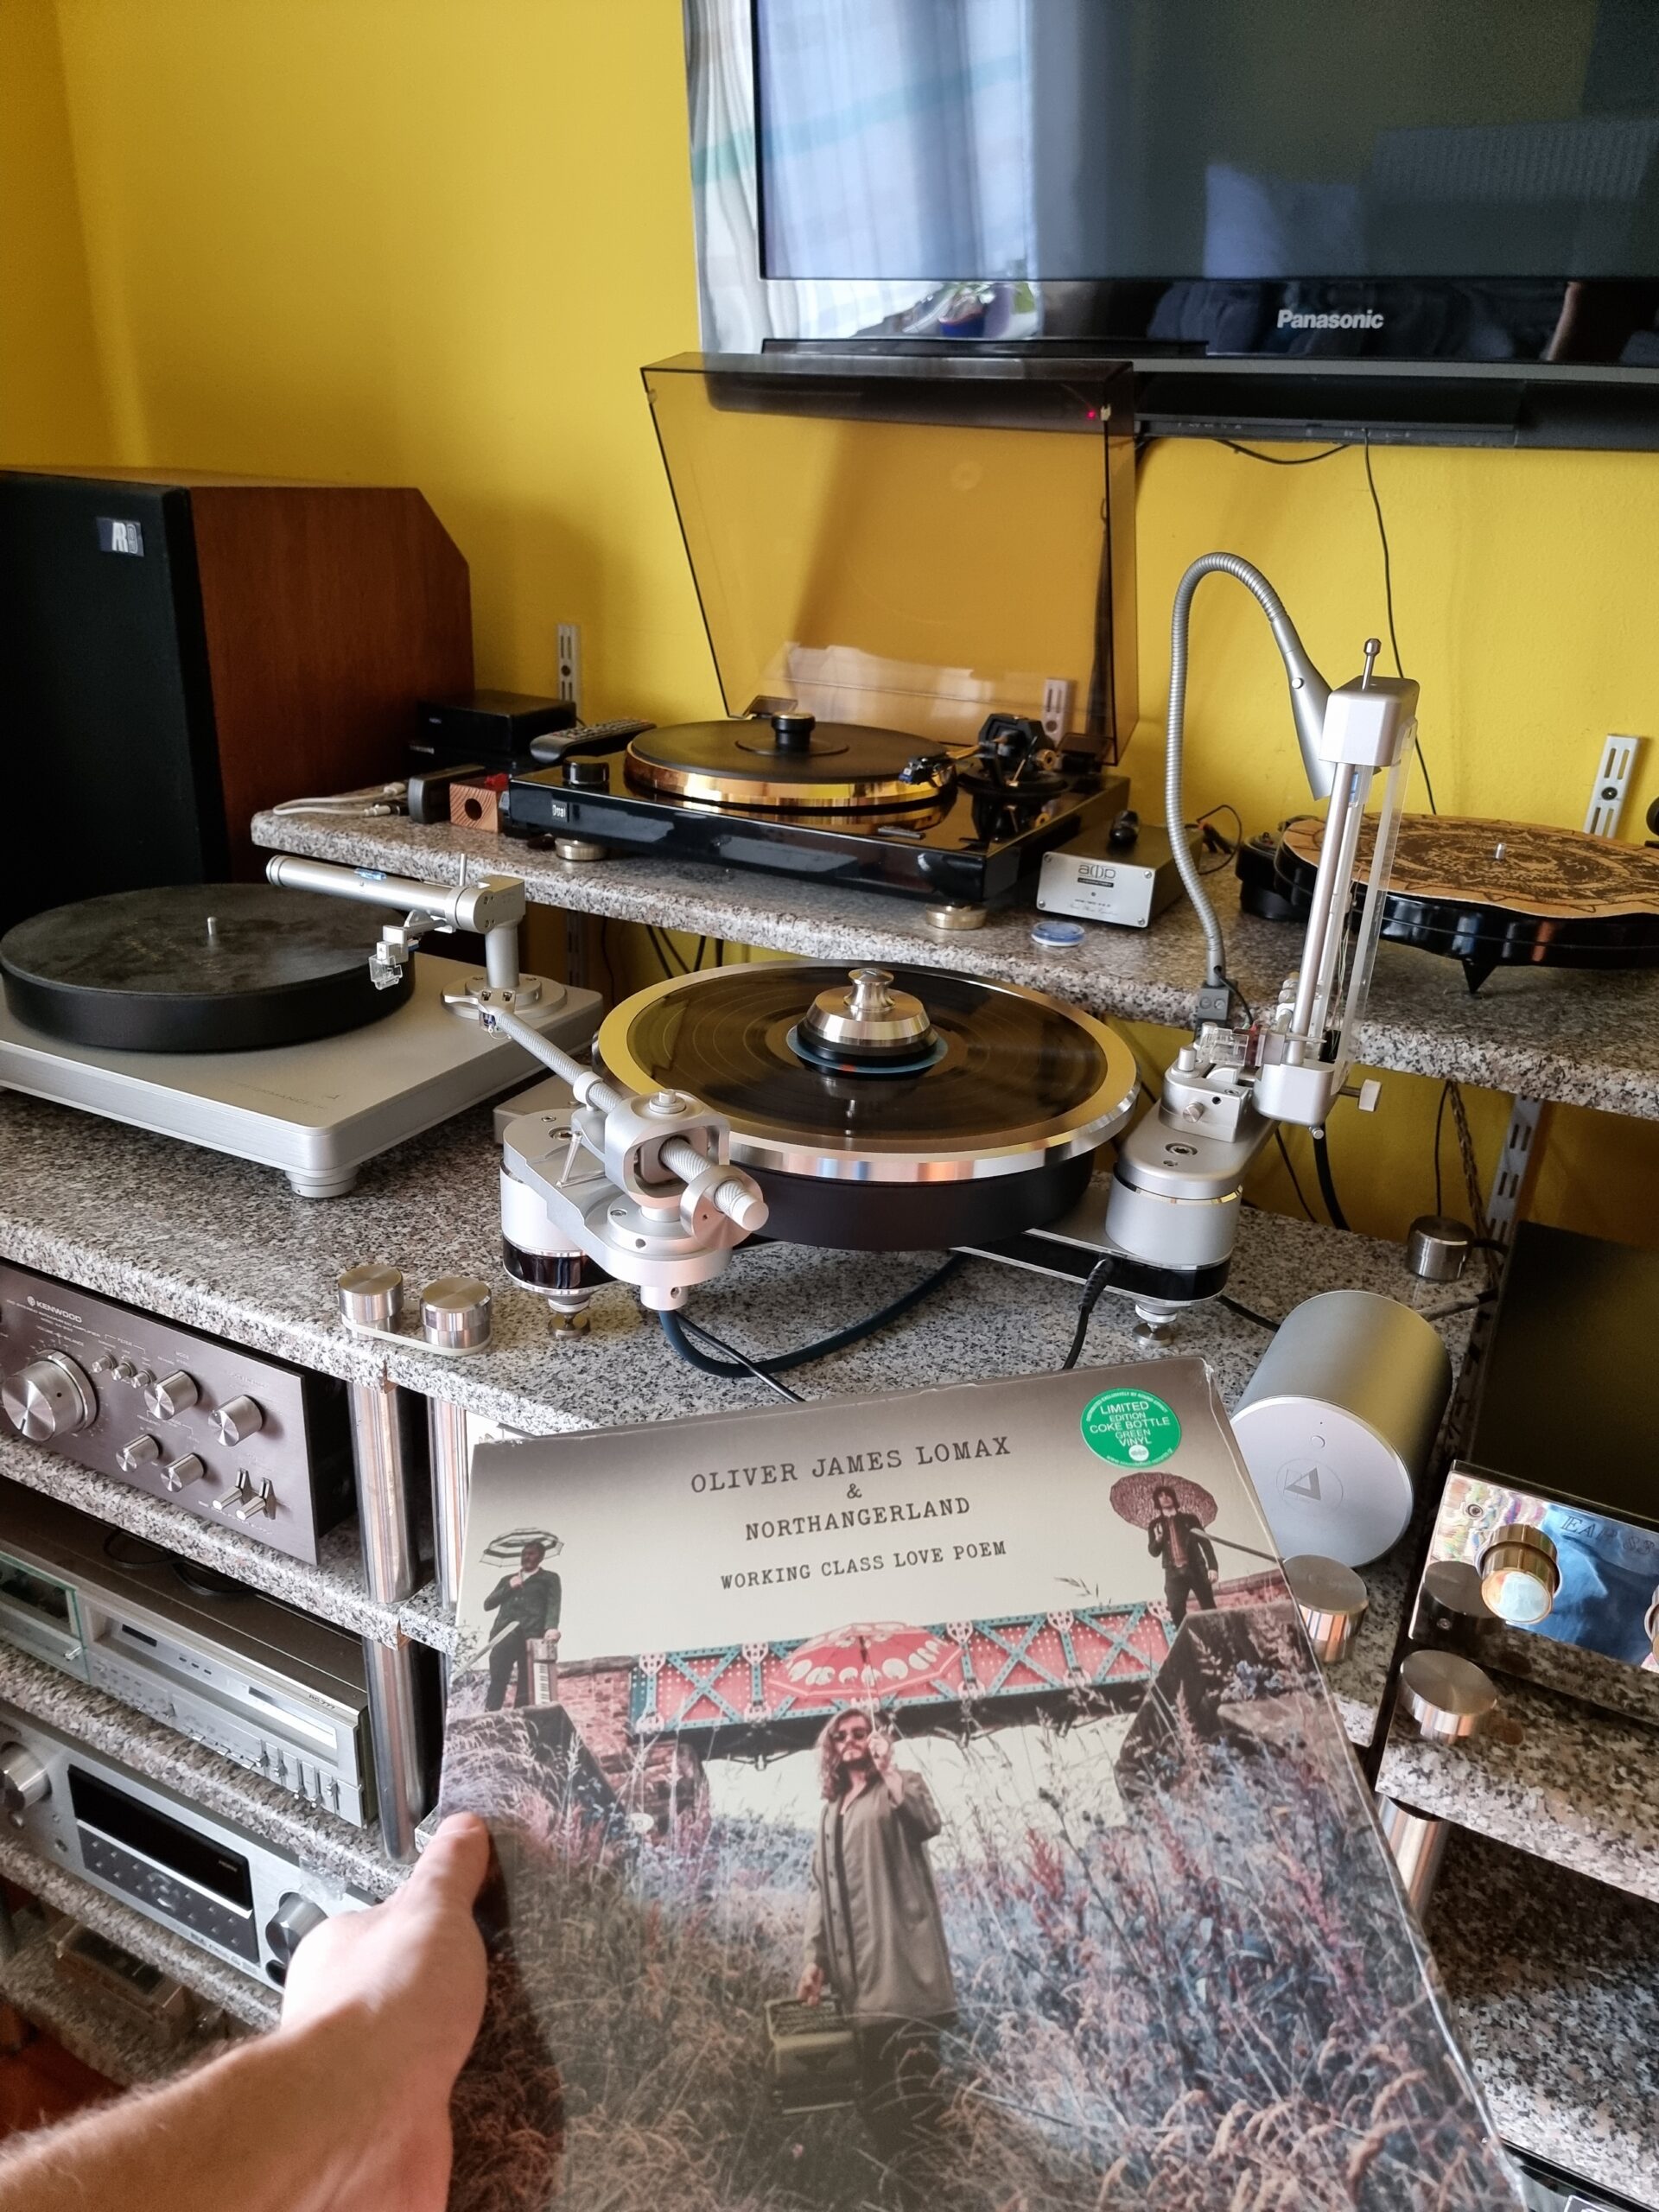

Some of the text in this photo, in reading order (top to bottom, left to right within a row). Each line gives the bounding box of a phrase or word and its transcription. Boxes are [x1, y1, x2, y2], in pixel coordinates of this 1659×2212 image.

[1277, 309, 1384, 328] Panasonic
[36, 1300, 83, 1323] KENWOOD
[1100, 1401, 1149, 1414] LIMITED
[1090, 1416, 1170, 1433] COKE BOTTLE
[1109, 1411, 1146, 1422] EDITION
[1115, 1428, 1151, 1440] GREEN
[1118, 1436, 1152, 1446] VINYL
[691, 1436, 1011, 1493] OLIVER JAMES LOMAX
[846, 1483, 862, 1499] &
[745, 1497, 970, 1541] NORTHANGERLAND
[721, 1540, 1007, 1590] WORKING CLASS LOVE POEM
